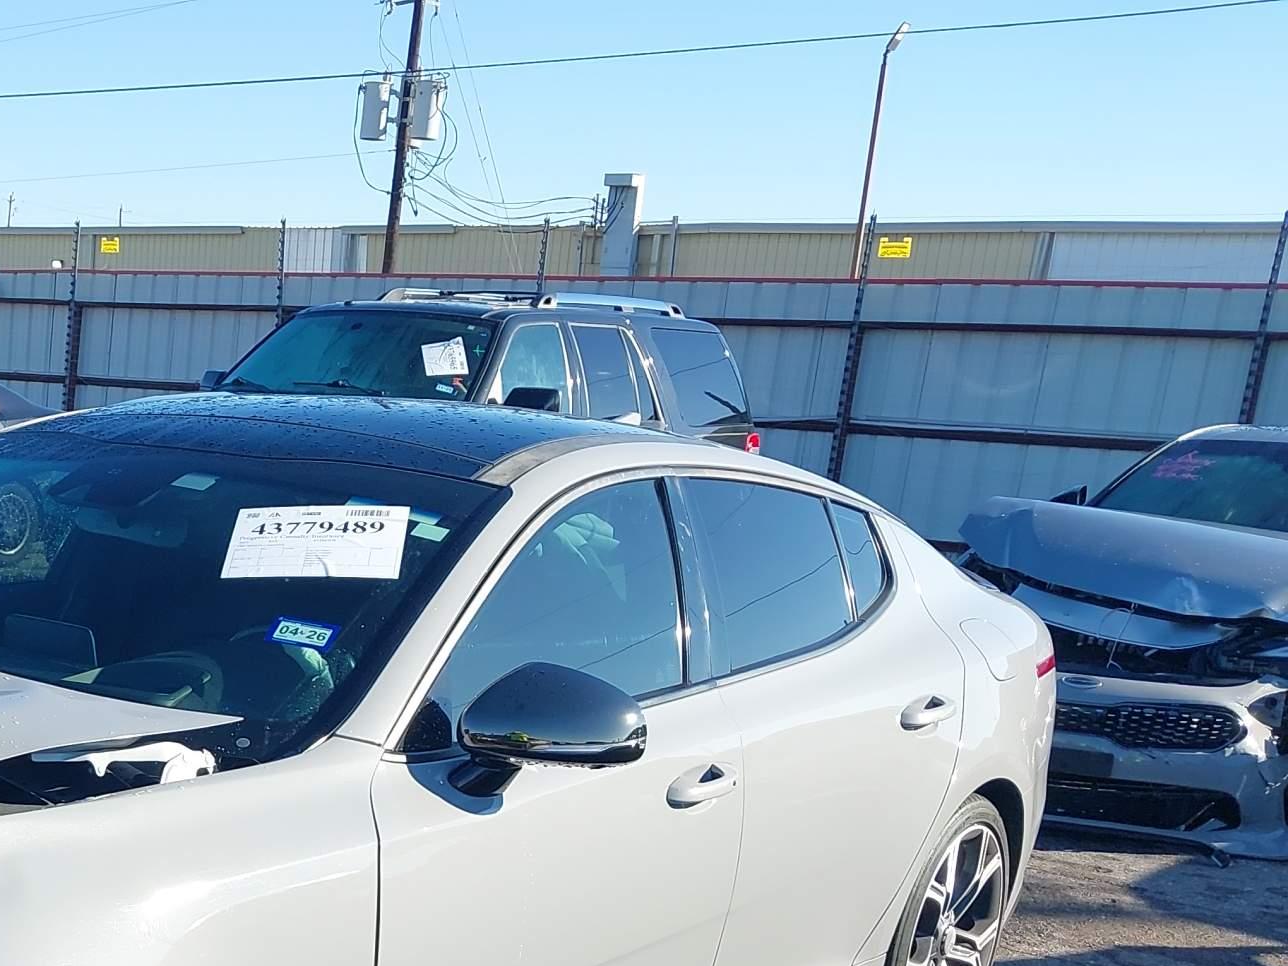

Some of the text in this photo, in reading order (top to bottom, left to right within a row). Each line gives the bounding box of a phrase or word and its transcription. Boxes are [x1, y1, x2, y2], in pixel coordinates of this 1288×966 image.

[251, 520, 385, 536] 43779489
[279, 625, 328, 642] 04 26
